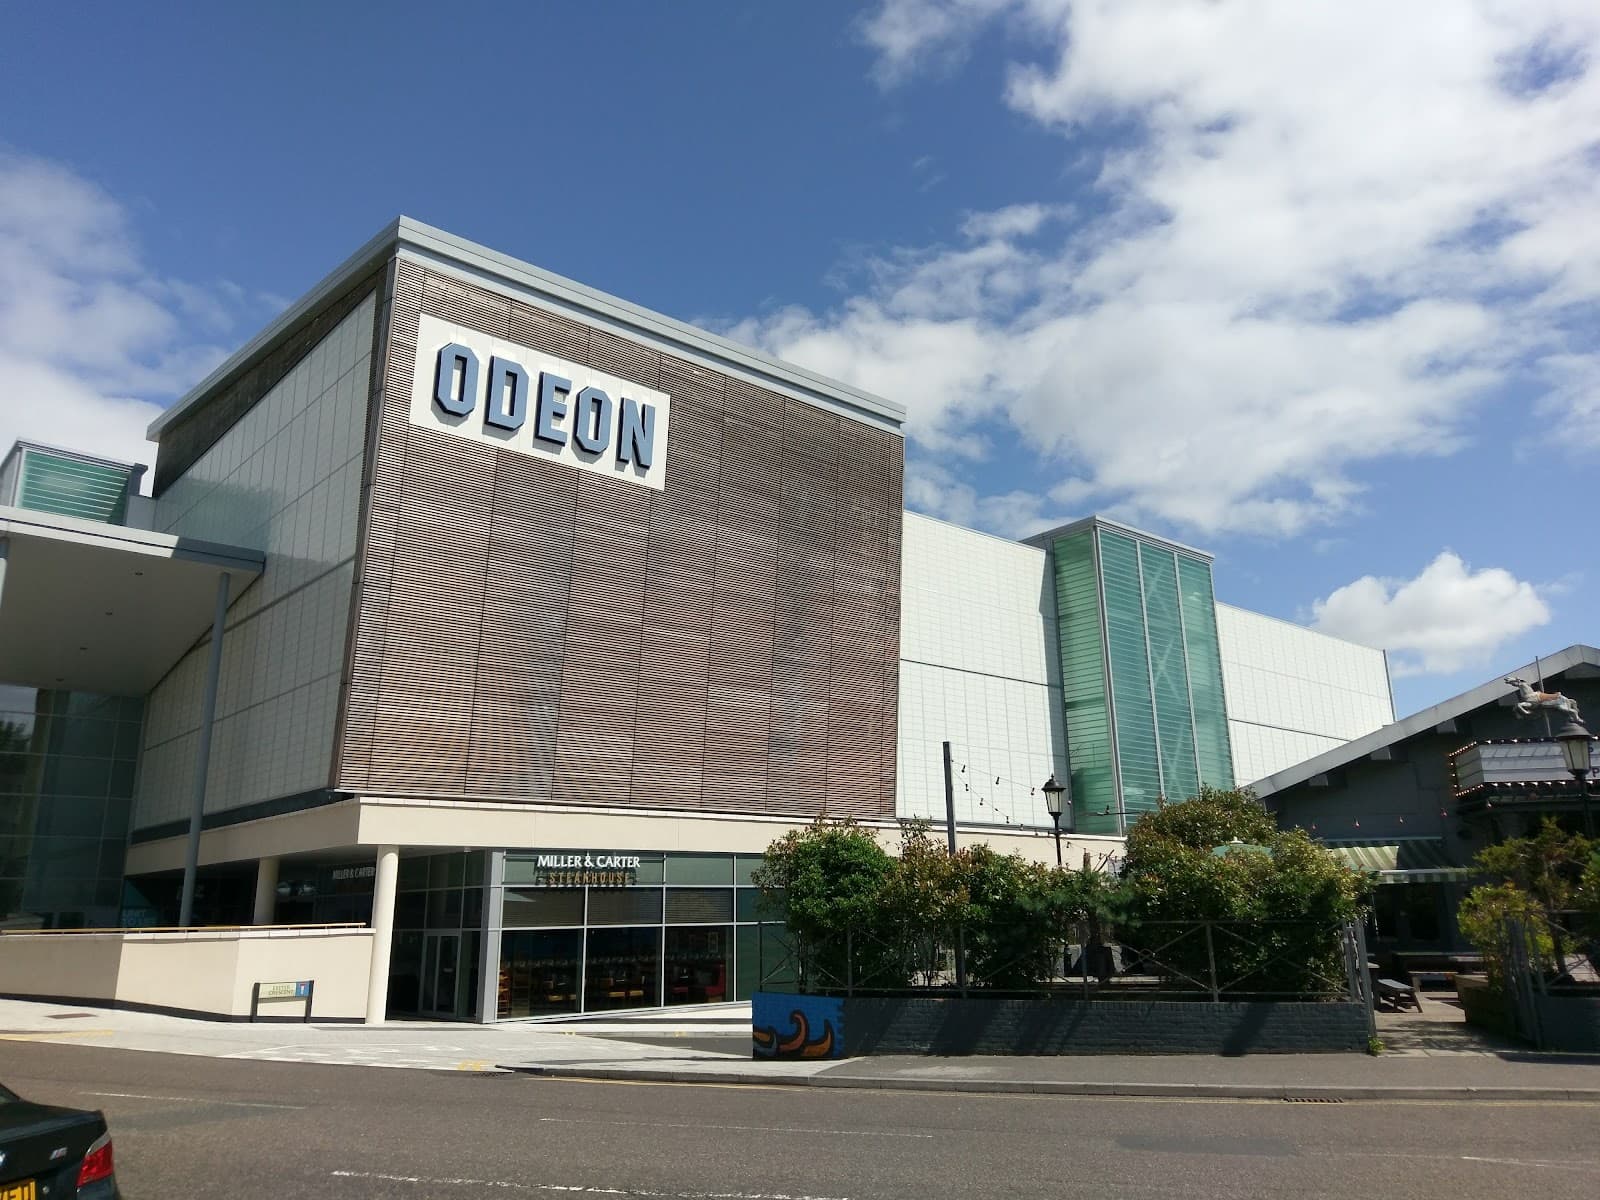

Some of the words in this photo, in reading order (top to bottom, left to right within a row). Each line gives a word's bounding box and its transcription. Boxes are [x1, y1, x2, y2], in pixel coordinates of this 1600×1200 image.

[433, 342, 656, 471] ODEON
[537, 855, 582, 868] MILLER
[584, 854, 594, 868] &
[596, 855, 641, 868] CARTER
[549, 871, 631, 884] STEAKHOUSE
